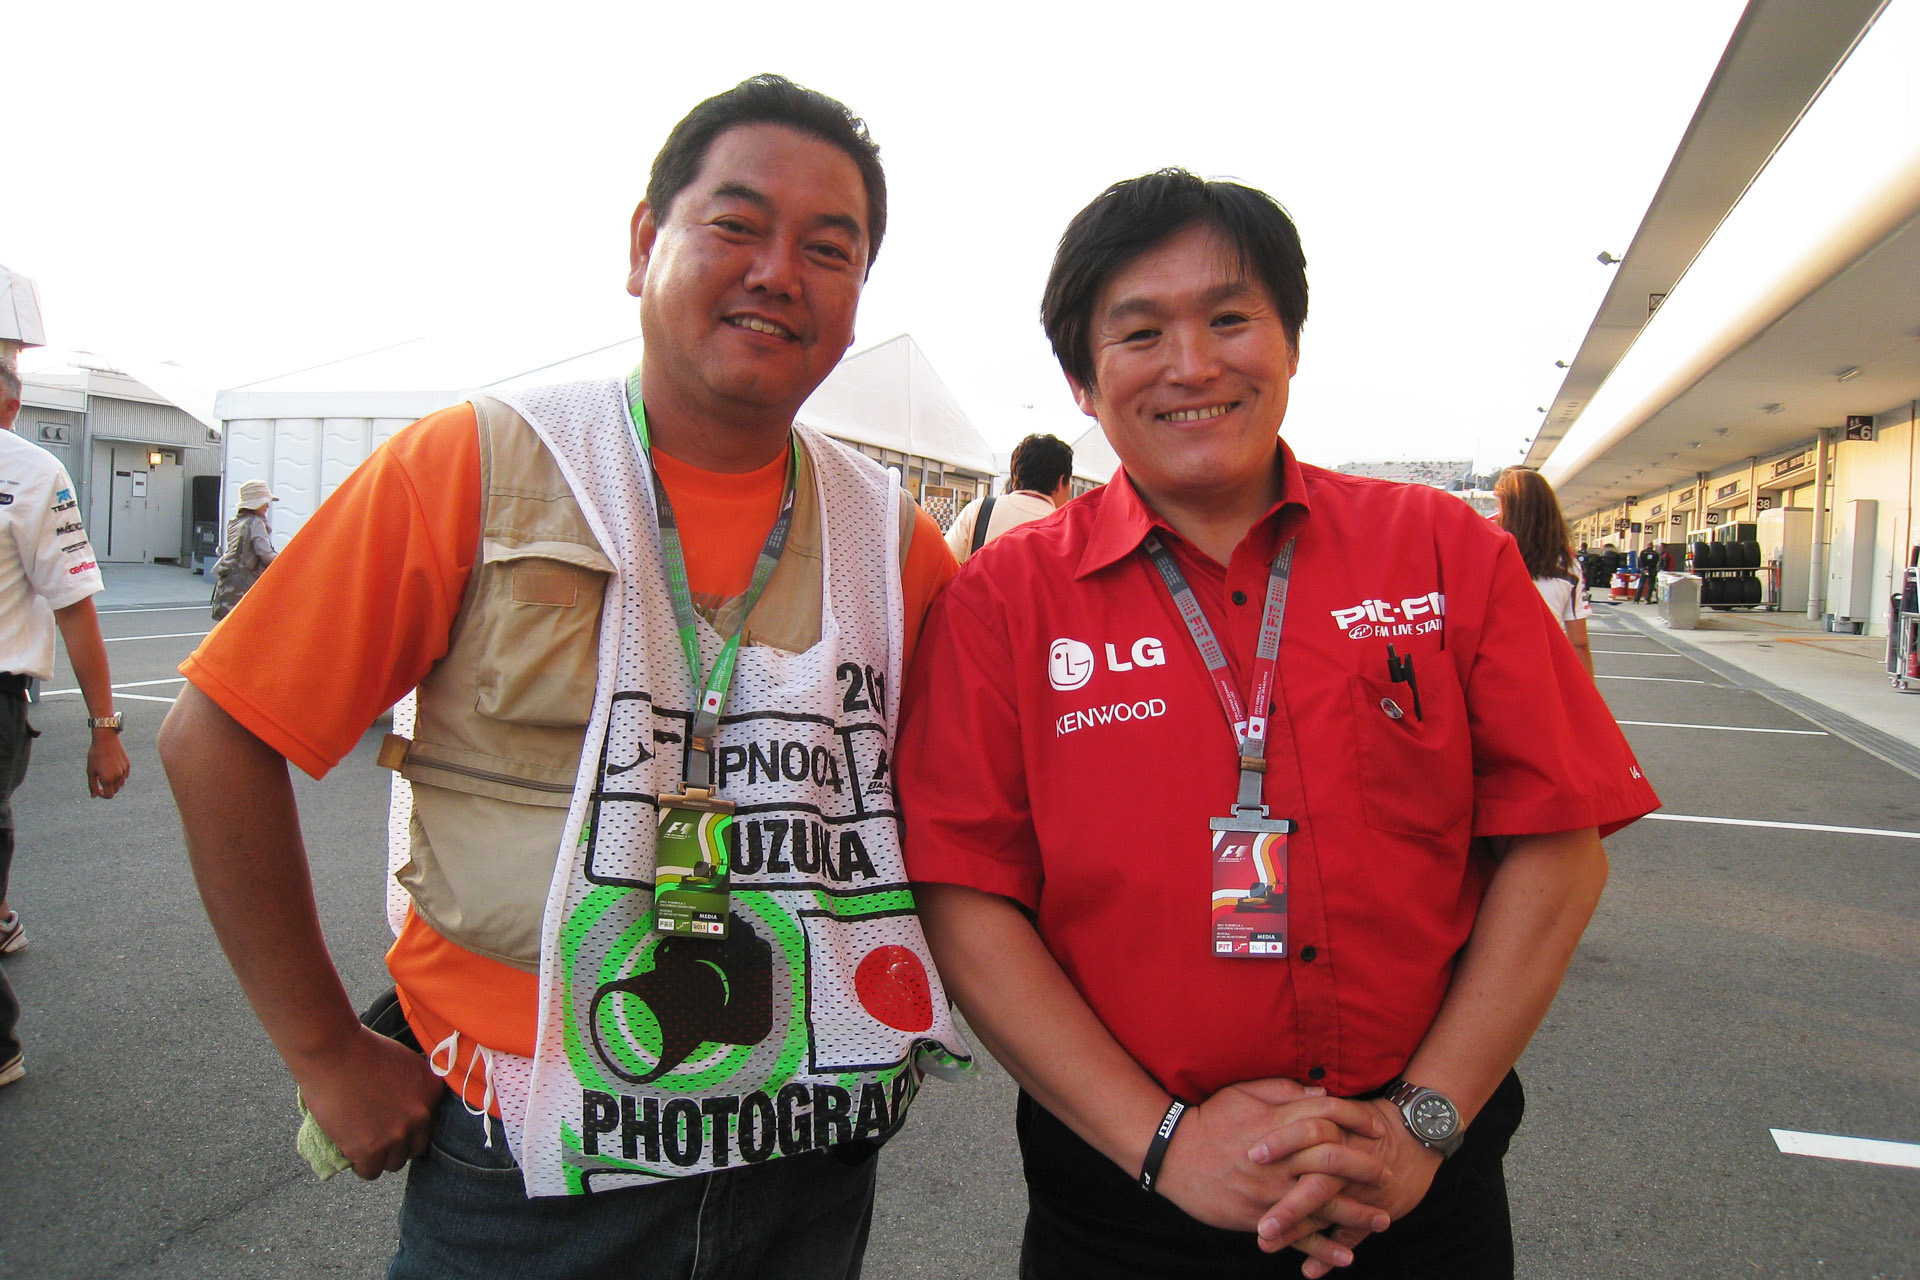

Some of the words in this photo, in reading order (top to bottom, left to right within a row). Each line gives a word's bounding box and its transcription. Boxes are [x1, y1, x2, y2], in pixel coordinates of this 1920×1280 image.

[1757, 499, 1770, 509] 38
[1707, 514, 1718, 524] 40
[1375, 625, 1389, 637] FM
[1392, 624, 1413, 636] LIVE
[1105, 637, 1166, 672] LG
[1056, 698, 1166, 738] KENWOOD
[730, 818, 880, 882] UZUKA
[1221, 845, 1248, 858] F1
[1158, 1101, 1185, 1139] PIRELLI
